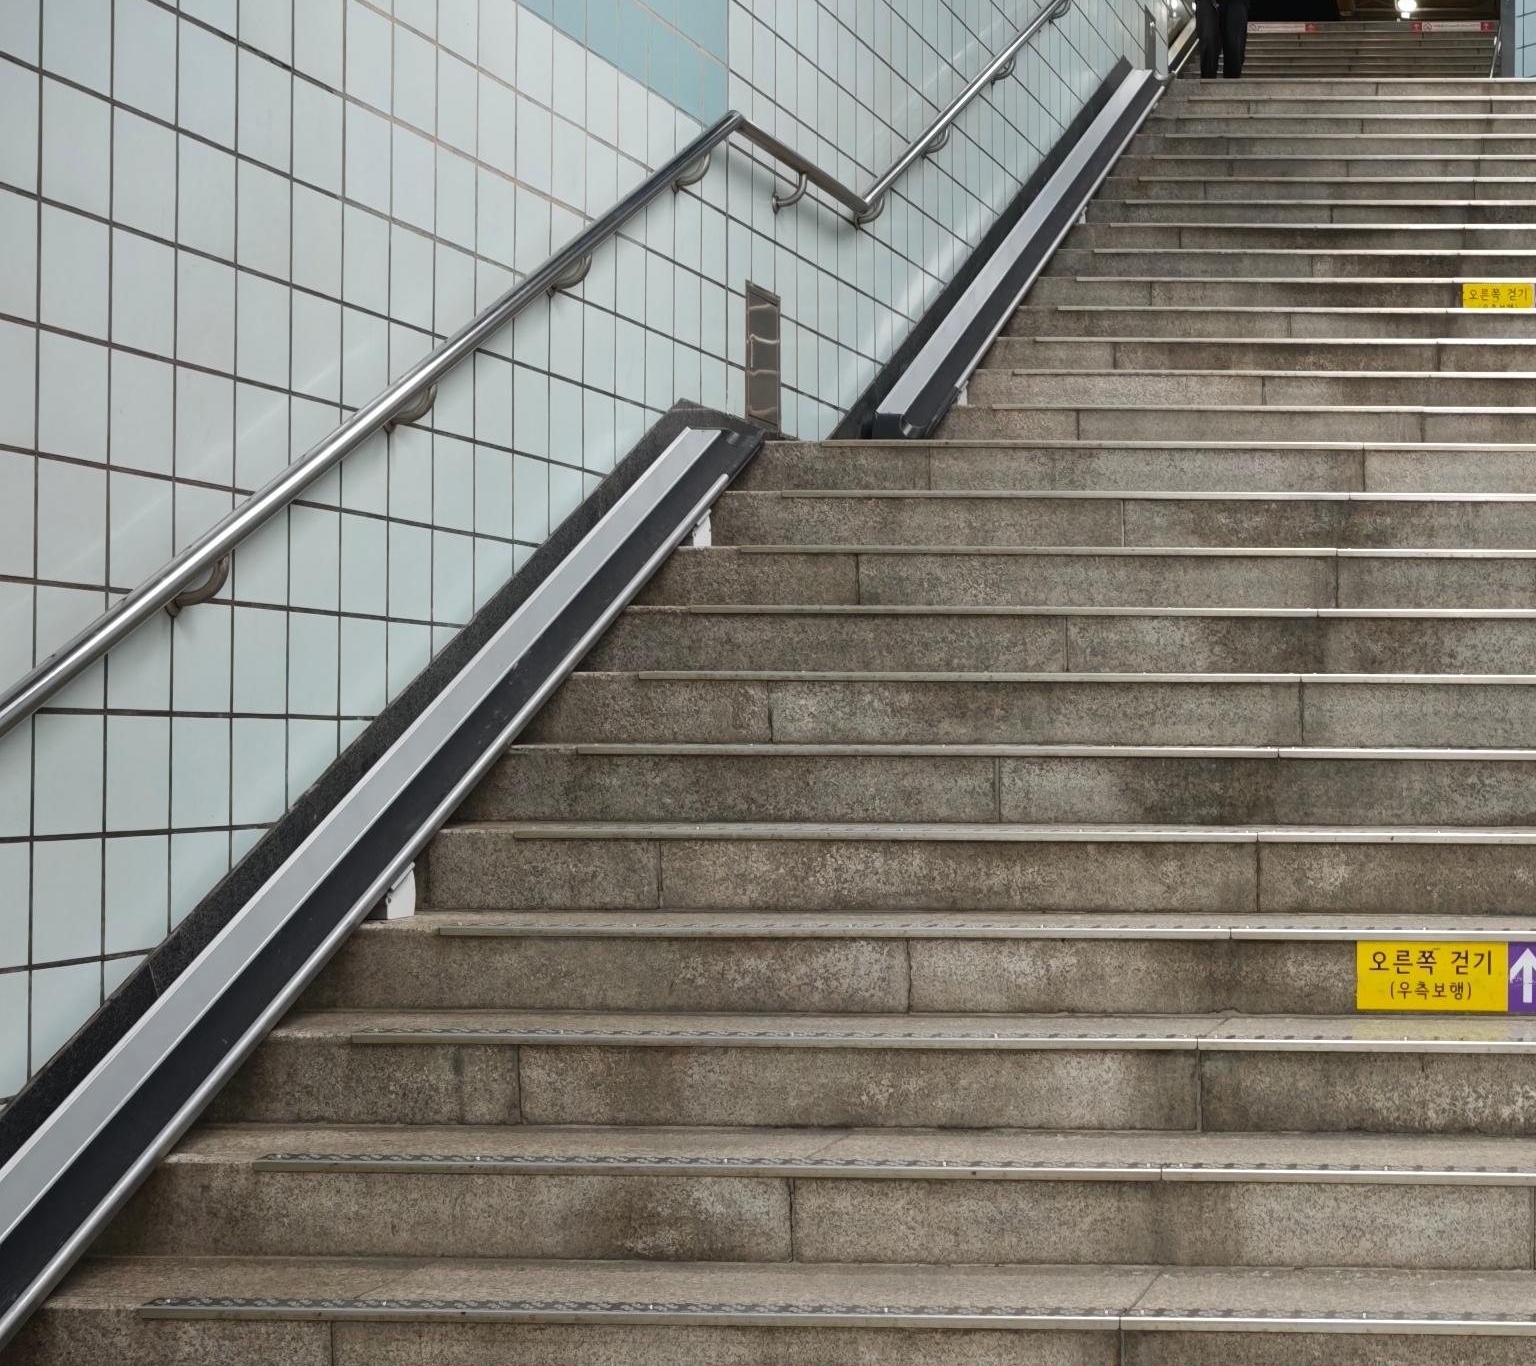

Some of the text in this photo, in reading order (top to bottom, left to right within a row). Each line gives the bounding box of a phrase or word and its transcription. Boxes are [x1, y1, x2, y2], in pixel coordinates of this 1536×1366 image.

[1469, 287, 1528, 301] 오른쪽 걷기
[1369, 949, 1493, 976] 오른쪽 걷기
[1390, 981, 1472, 1001] (우측보행)
